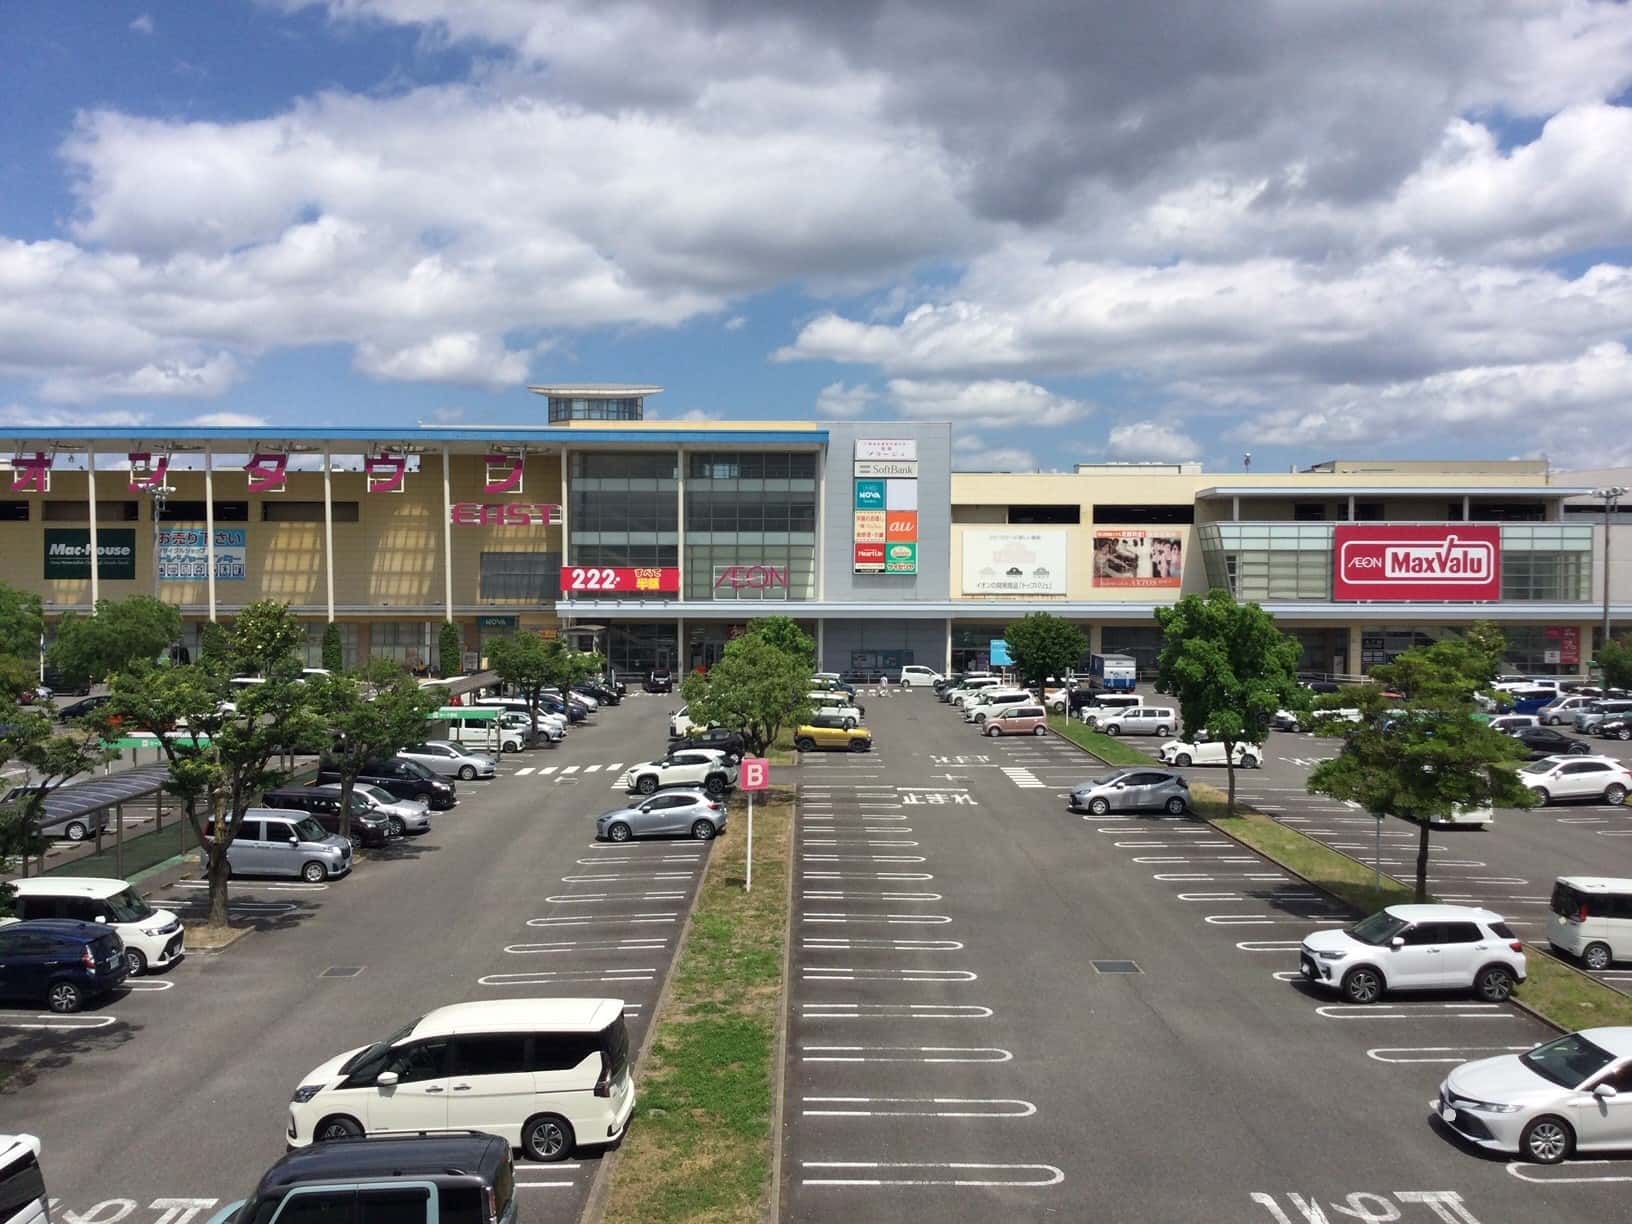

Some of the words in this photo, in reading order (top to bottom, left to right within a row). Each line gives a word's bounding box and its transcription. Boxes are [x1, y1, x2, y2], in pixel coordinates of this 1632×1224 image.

[873, 464, 912, 474] SoftBank
[859, 491, 881, 499] NOVA
[453, 502, 561, 526] EAST
[889, 521, 915, 532] au
[1391, 538, 1482, 574] MaxValu
[747, 764, 764, 787] B
[902, 792, 979, 805] 止まれ
